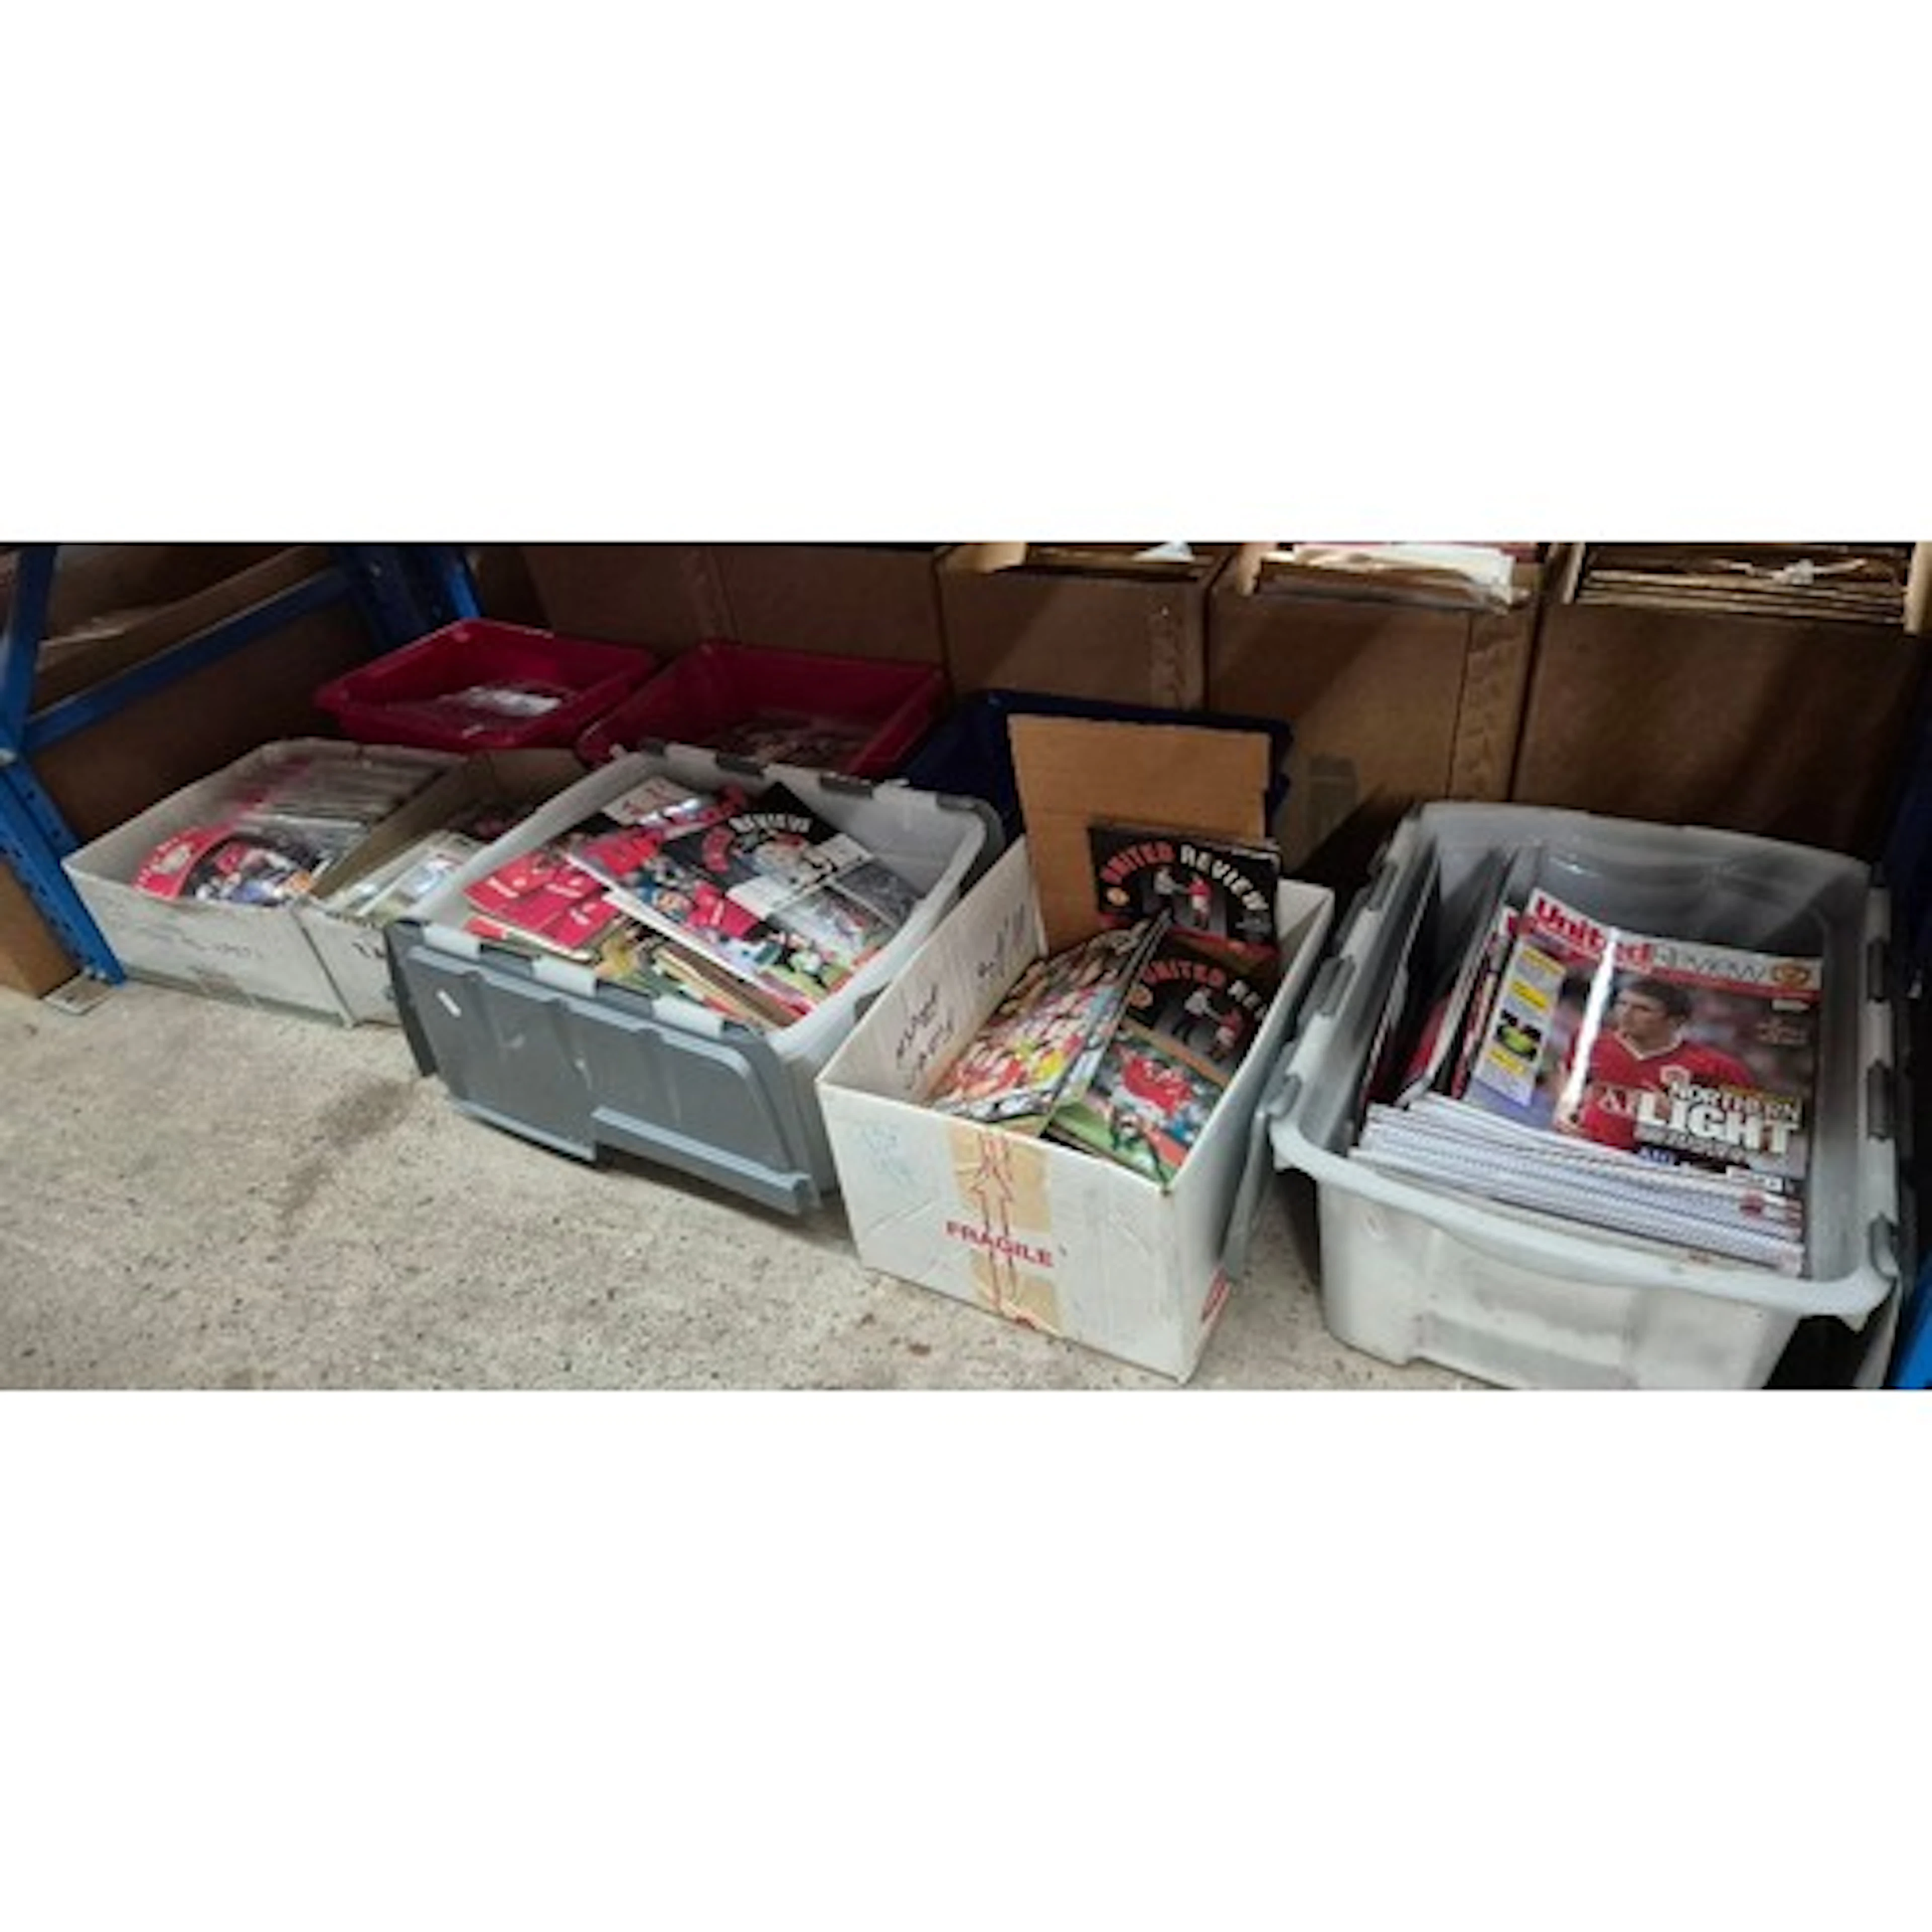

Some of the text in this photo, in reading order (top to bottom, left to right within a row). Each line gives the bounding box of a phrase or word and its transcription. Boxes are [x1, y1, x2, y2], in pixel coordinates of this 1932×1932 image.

[729, 813, 813, 833] REVIEW
[1180, 843, 1269, 911] REVIEW
[1638, 1090, 1800, 1154] LIGHT
[1668, 1081, 1801, 1123] NORTHERN
[946, 1220, 1054, 1267] FRAGILE
